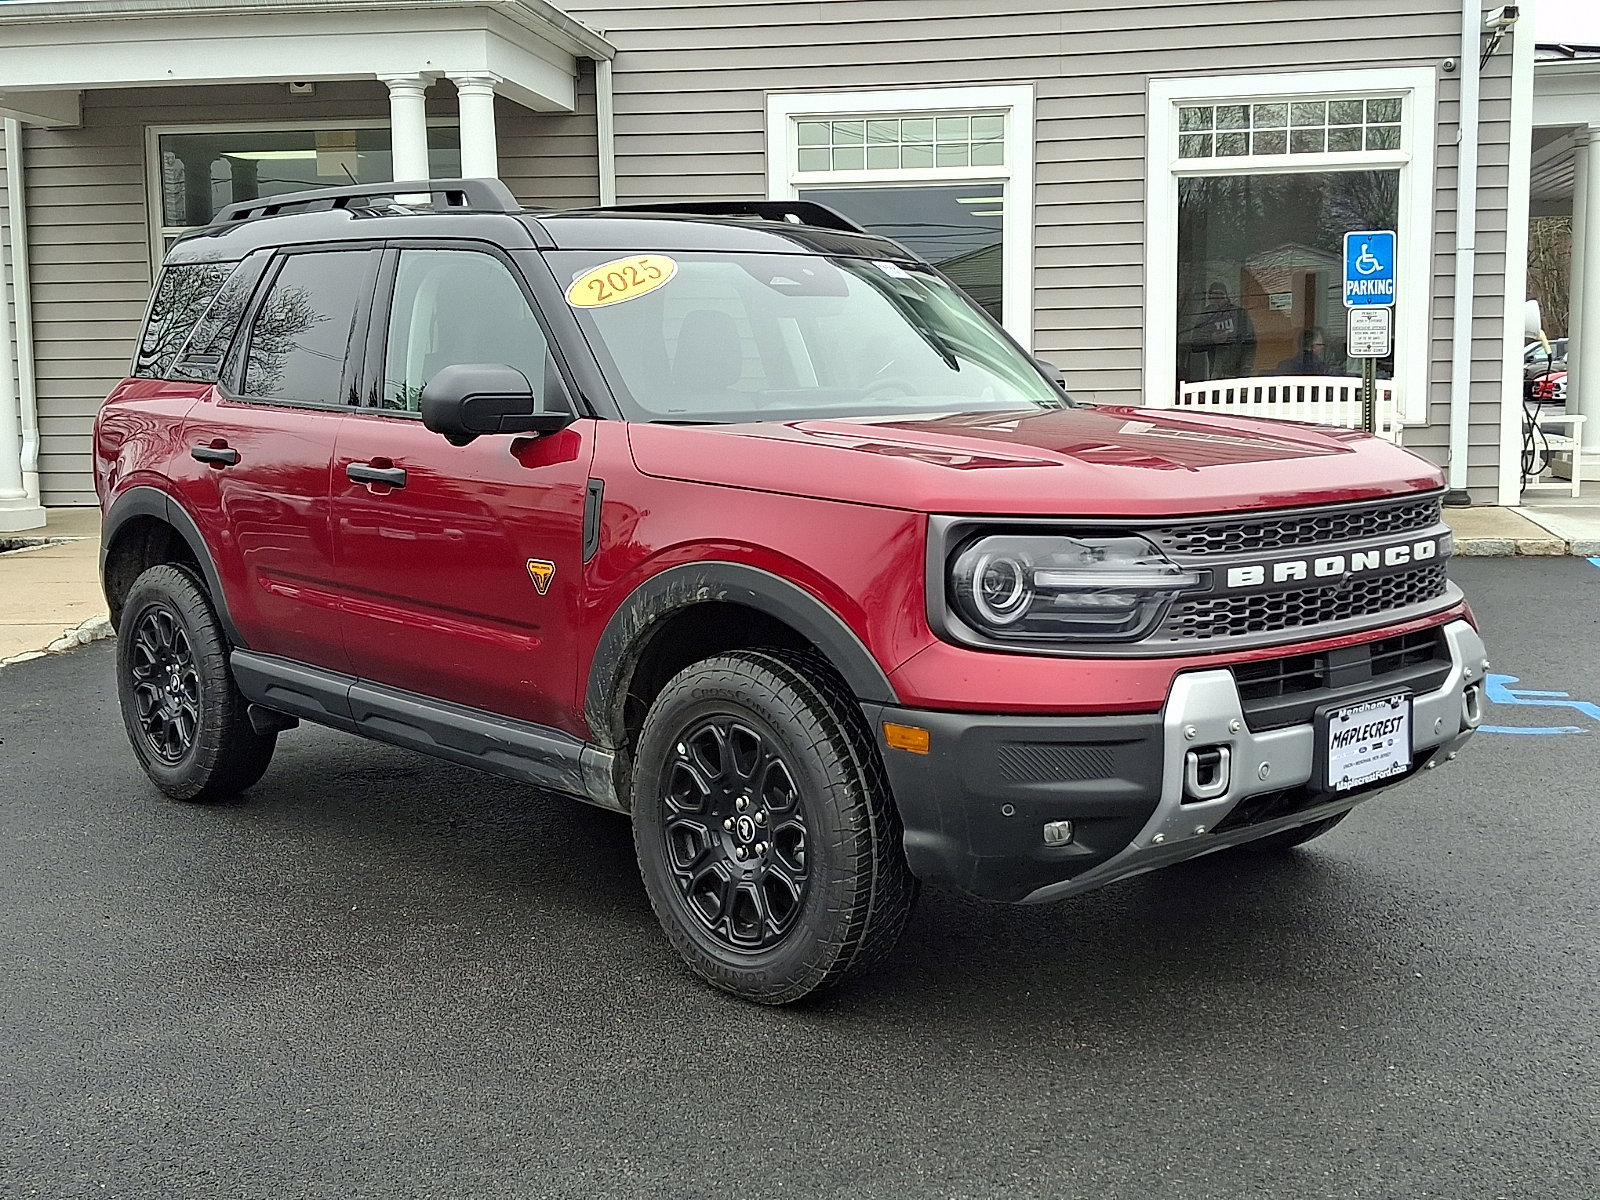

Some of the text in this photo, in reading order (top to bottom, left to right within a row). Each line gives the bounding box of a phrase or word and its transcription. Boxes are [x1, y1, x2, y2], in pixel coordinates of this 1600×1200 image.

[587, 259, 662, 301] 2025
[1346, 279, 1393, 296] PARKING
[1227, 540, 1436, 588] BRONCO
[1390, 695, 1405, 704] NJ
[1331, 715, 1404, 750] MAPLECREST
[1336, 764, 1407, 791] MaplecrestFord.com
